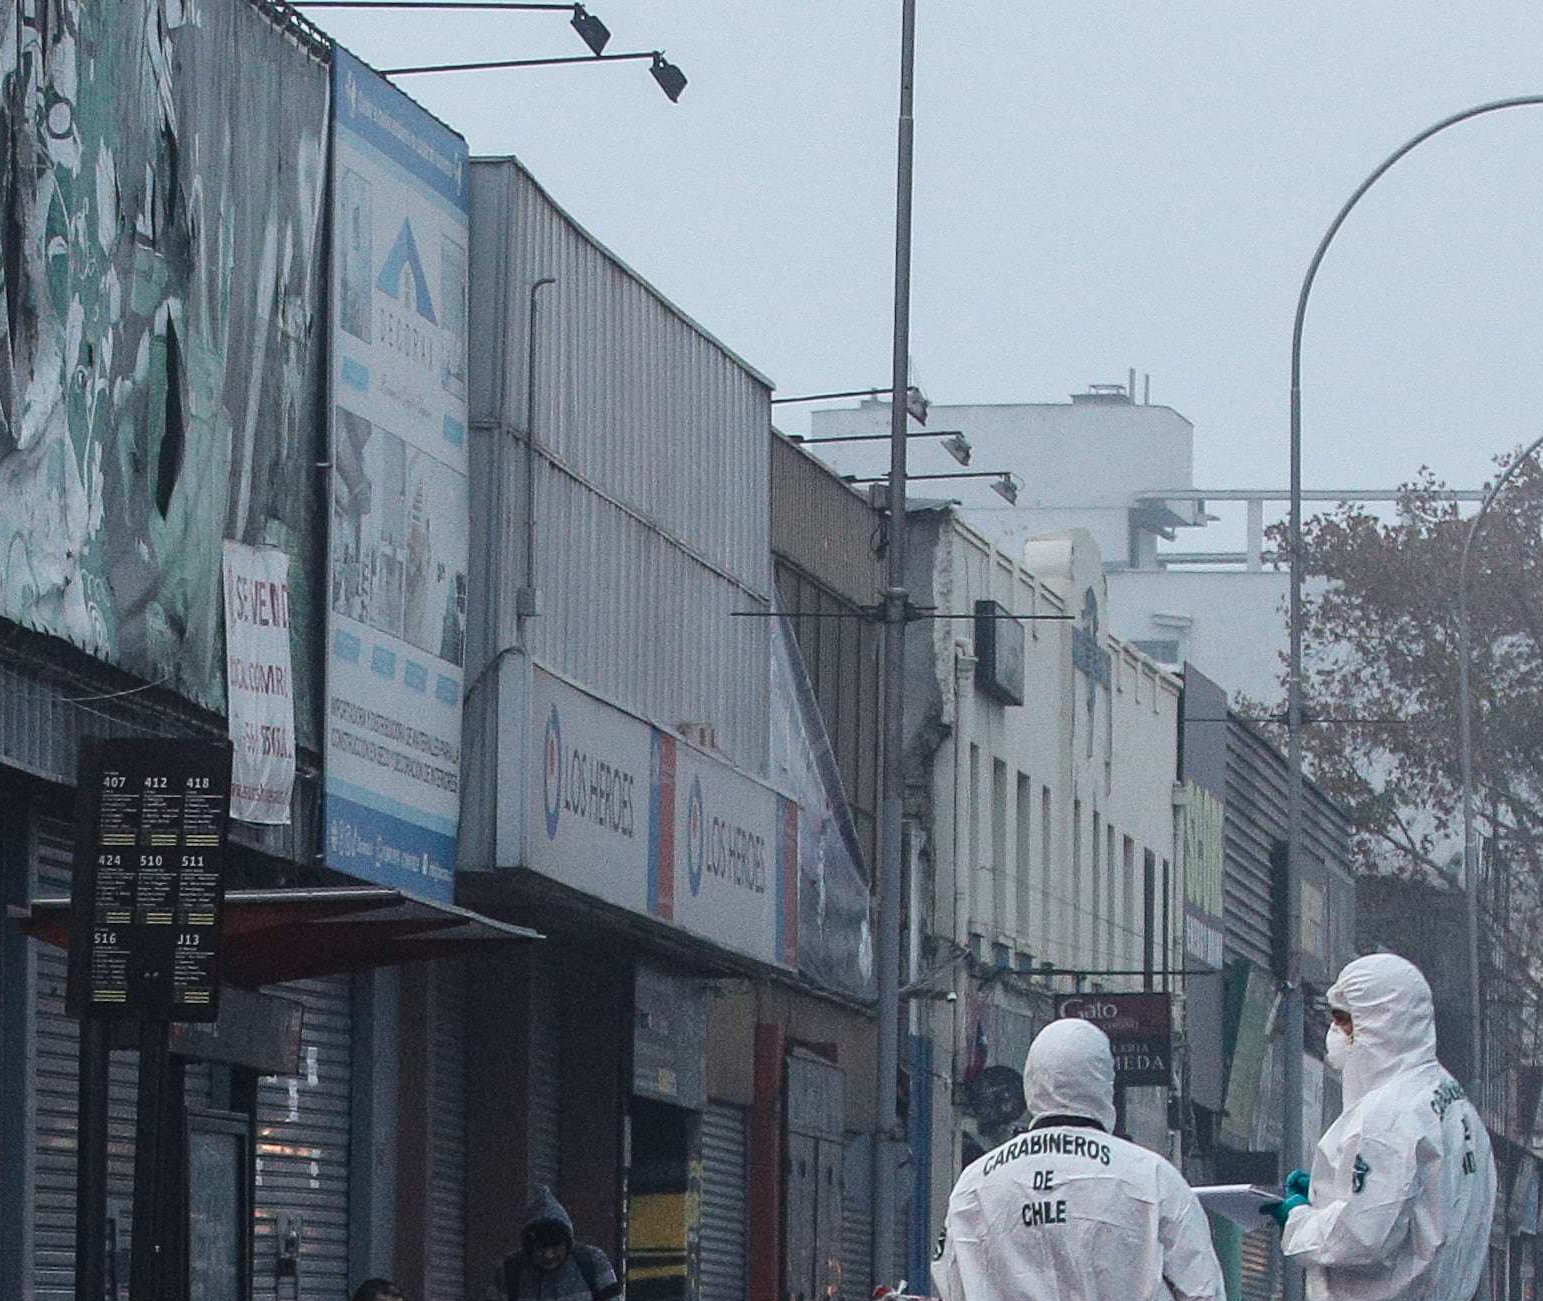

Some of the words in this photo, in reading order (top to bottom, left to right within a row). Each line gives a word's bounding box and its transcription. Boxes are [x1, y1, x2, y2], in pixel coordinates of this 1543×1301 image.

[102, 776, 126, 788] 407
[144, 777, 168, 788] 412
[186, 777, 210, 789] 418
[564, 746, 586, 817] LOS
[706, 816, 726, 878] LOS
[98, 855, 121, 866] 424
[140, 856, 163, 867] 510
[182, 856, 204, 867] 511
[94, 932, 117, 944] 516
[177, 933, 200, 945] J13
[1059, 999, 1118, 1019] Gato
[983, 1132, 1112, 1177] CARABINEROS
[1033, 1170, 1055, 1191] DE
[1022, 1200, 1067, 1227] CHLE
